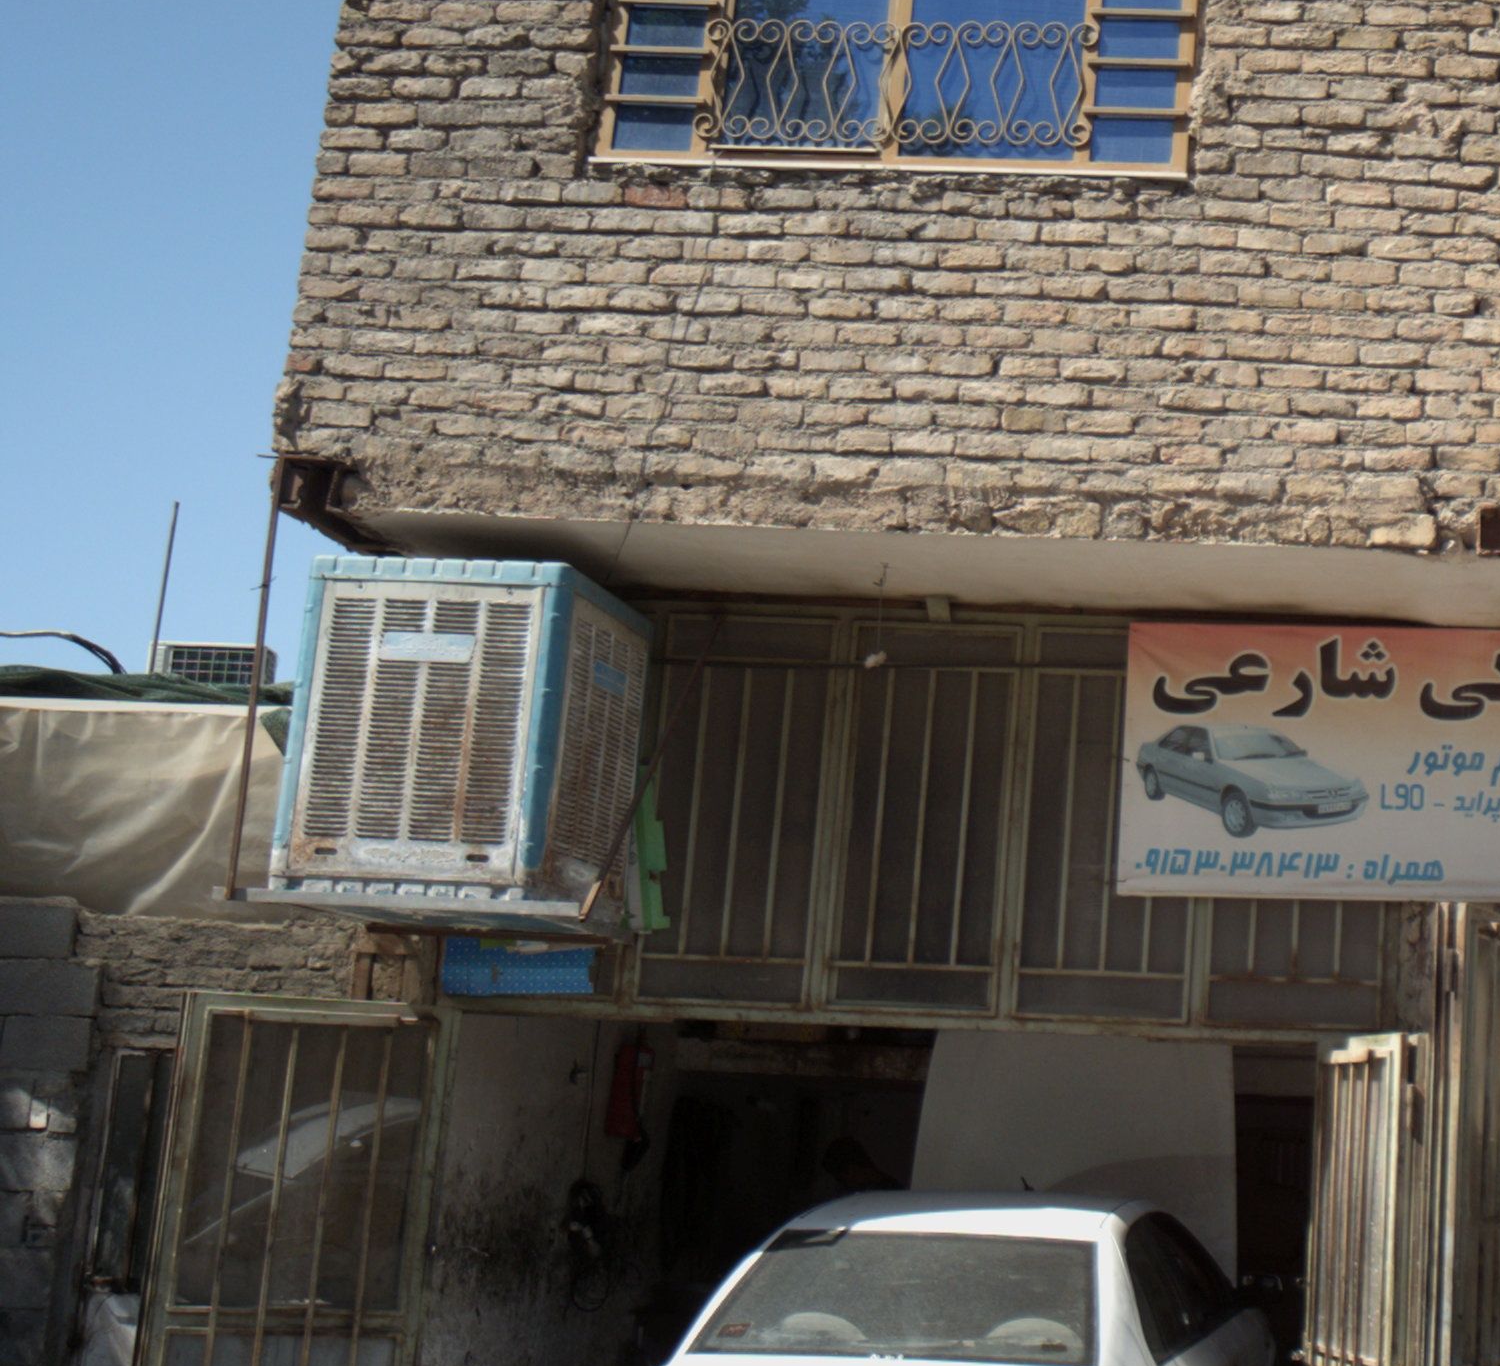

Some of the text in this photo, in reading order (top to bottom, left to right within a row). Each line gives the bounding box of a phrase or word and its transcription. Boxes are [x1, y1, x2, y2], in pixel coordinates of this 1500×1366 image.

[1152, 637, 1396, 718] شارعی
[1406, 744, 1486, 776] موتور
[1379, 783, 1425, 811] L90
[1362, 854, 1445, 885] همراه
